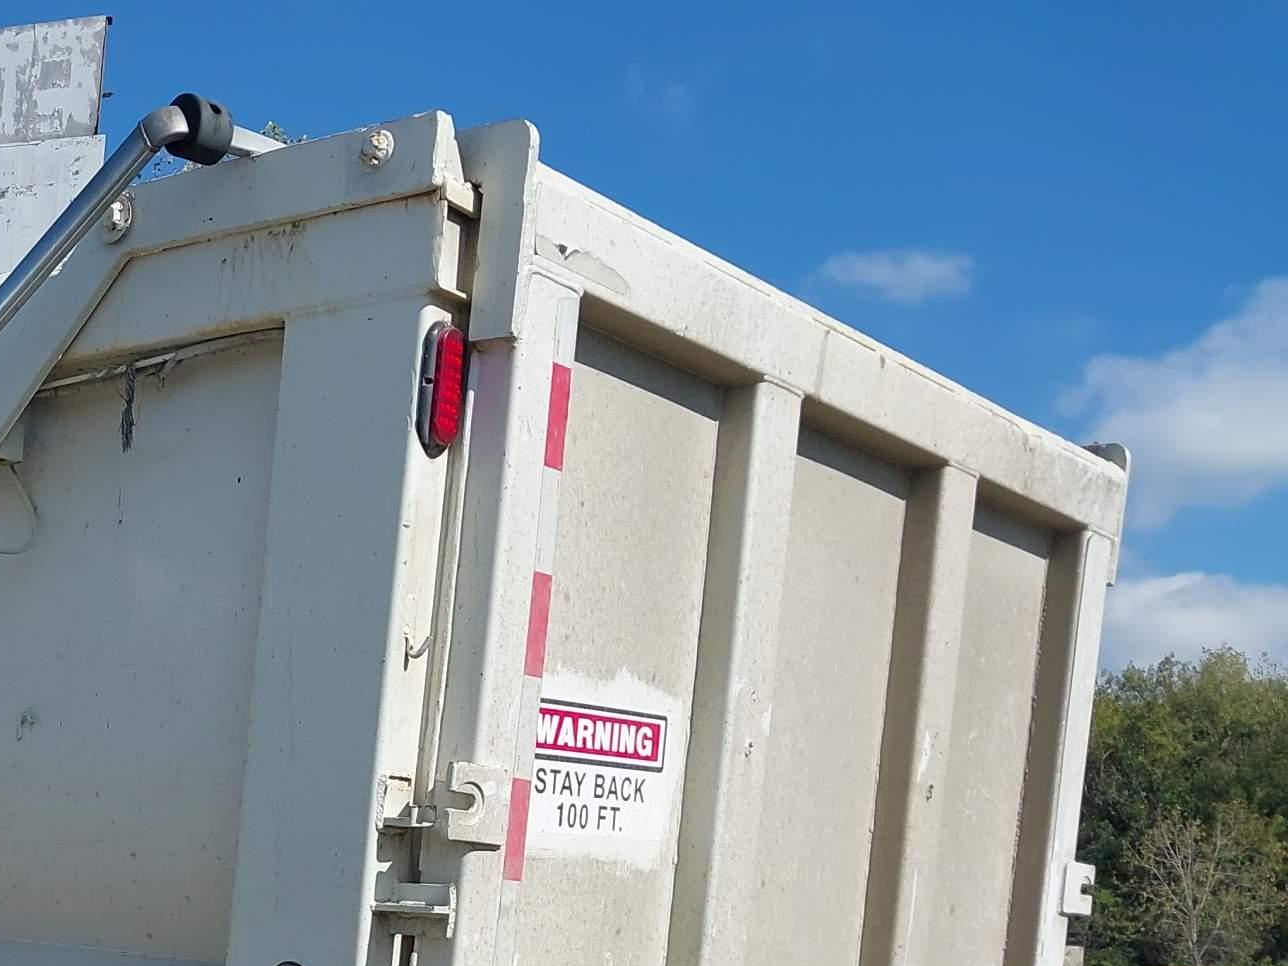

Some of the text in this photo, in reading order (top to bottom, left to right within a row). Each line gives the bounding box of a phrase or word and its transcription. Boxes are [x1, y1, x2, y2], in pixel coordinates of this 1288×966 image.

[536, 712, 654, 757] WARNING
[534, 767, 647, 803] STAY BACK
[556, 802, 623, 832] 100 FT.
